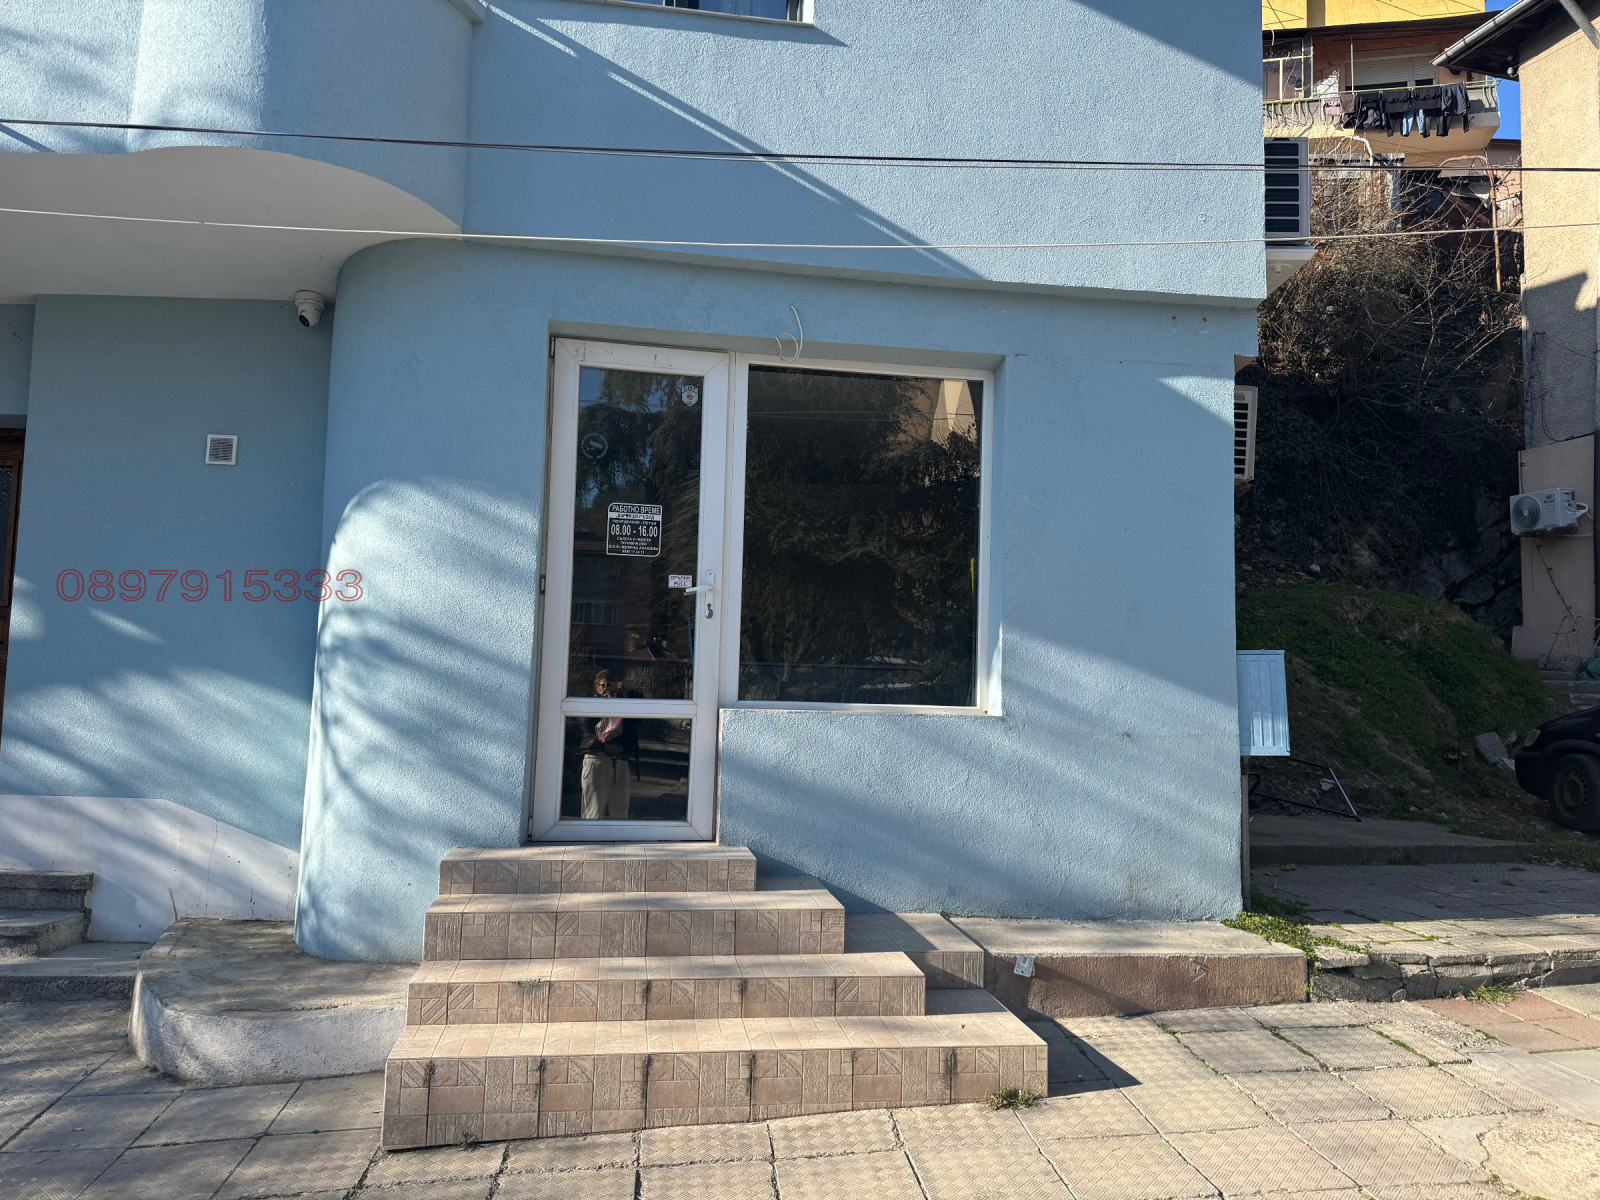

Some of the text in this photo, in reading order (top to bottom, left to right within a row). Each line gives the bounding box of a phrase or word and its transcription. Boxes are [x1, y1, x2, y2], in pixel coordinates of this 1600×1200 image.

[612, 504, 660, 515] РАБОТНО ВРЕМЕ
[611, 524, 632, 536] 08.00
[638, 525, 658, 538] 16.00
